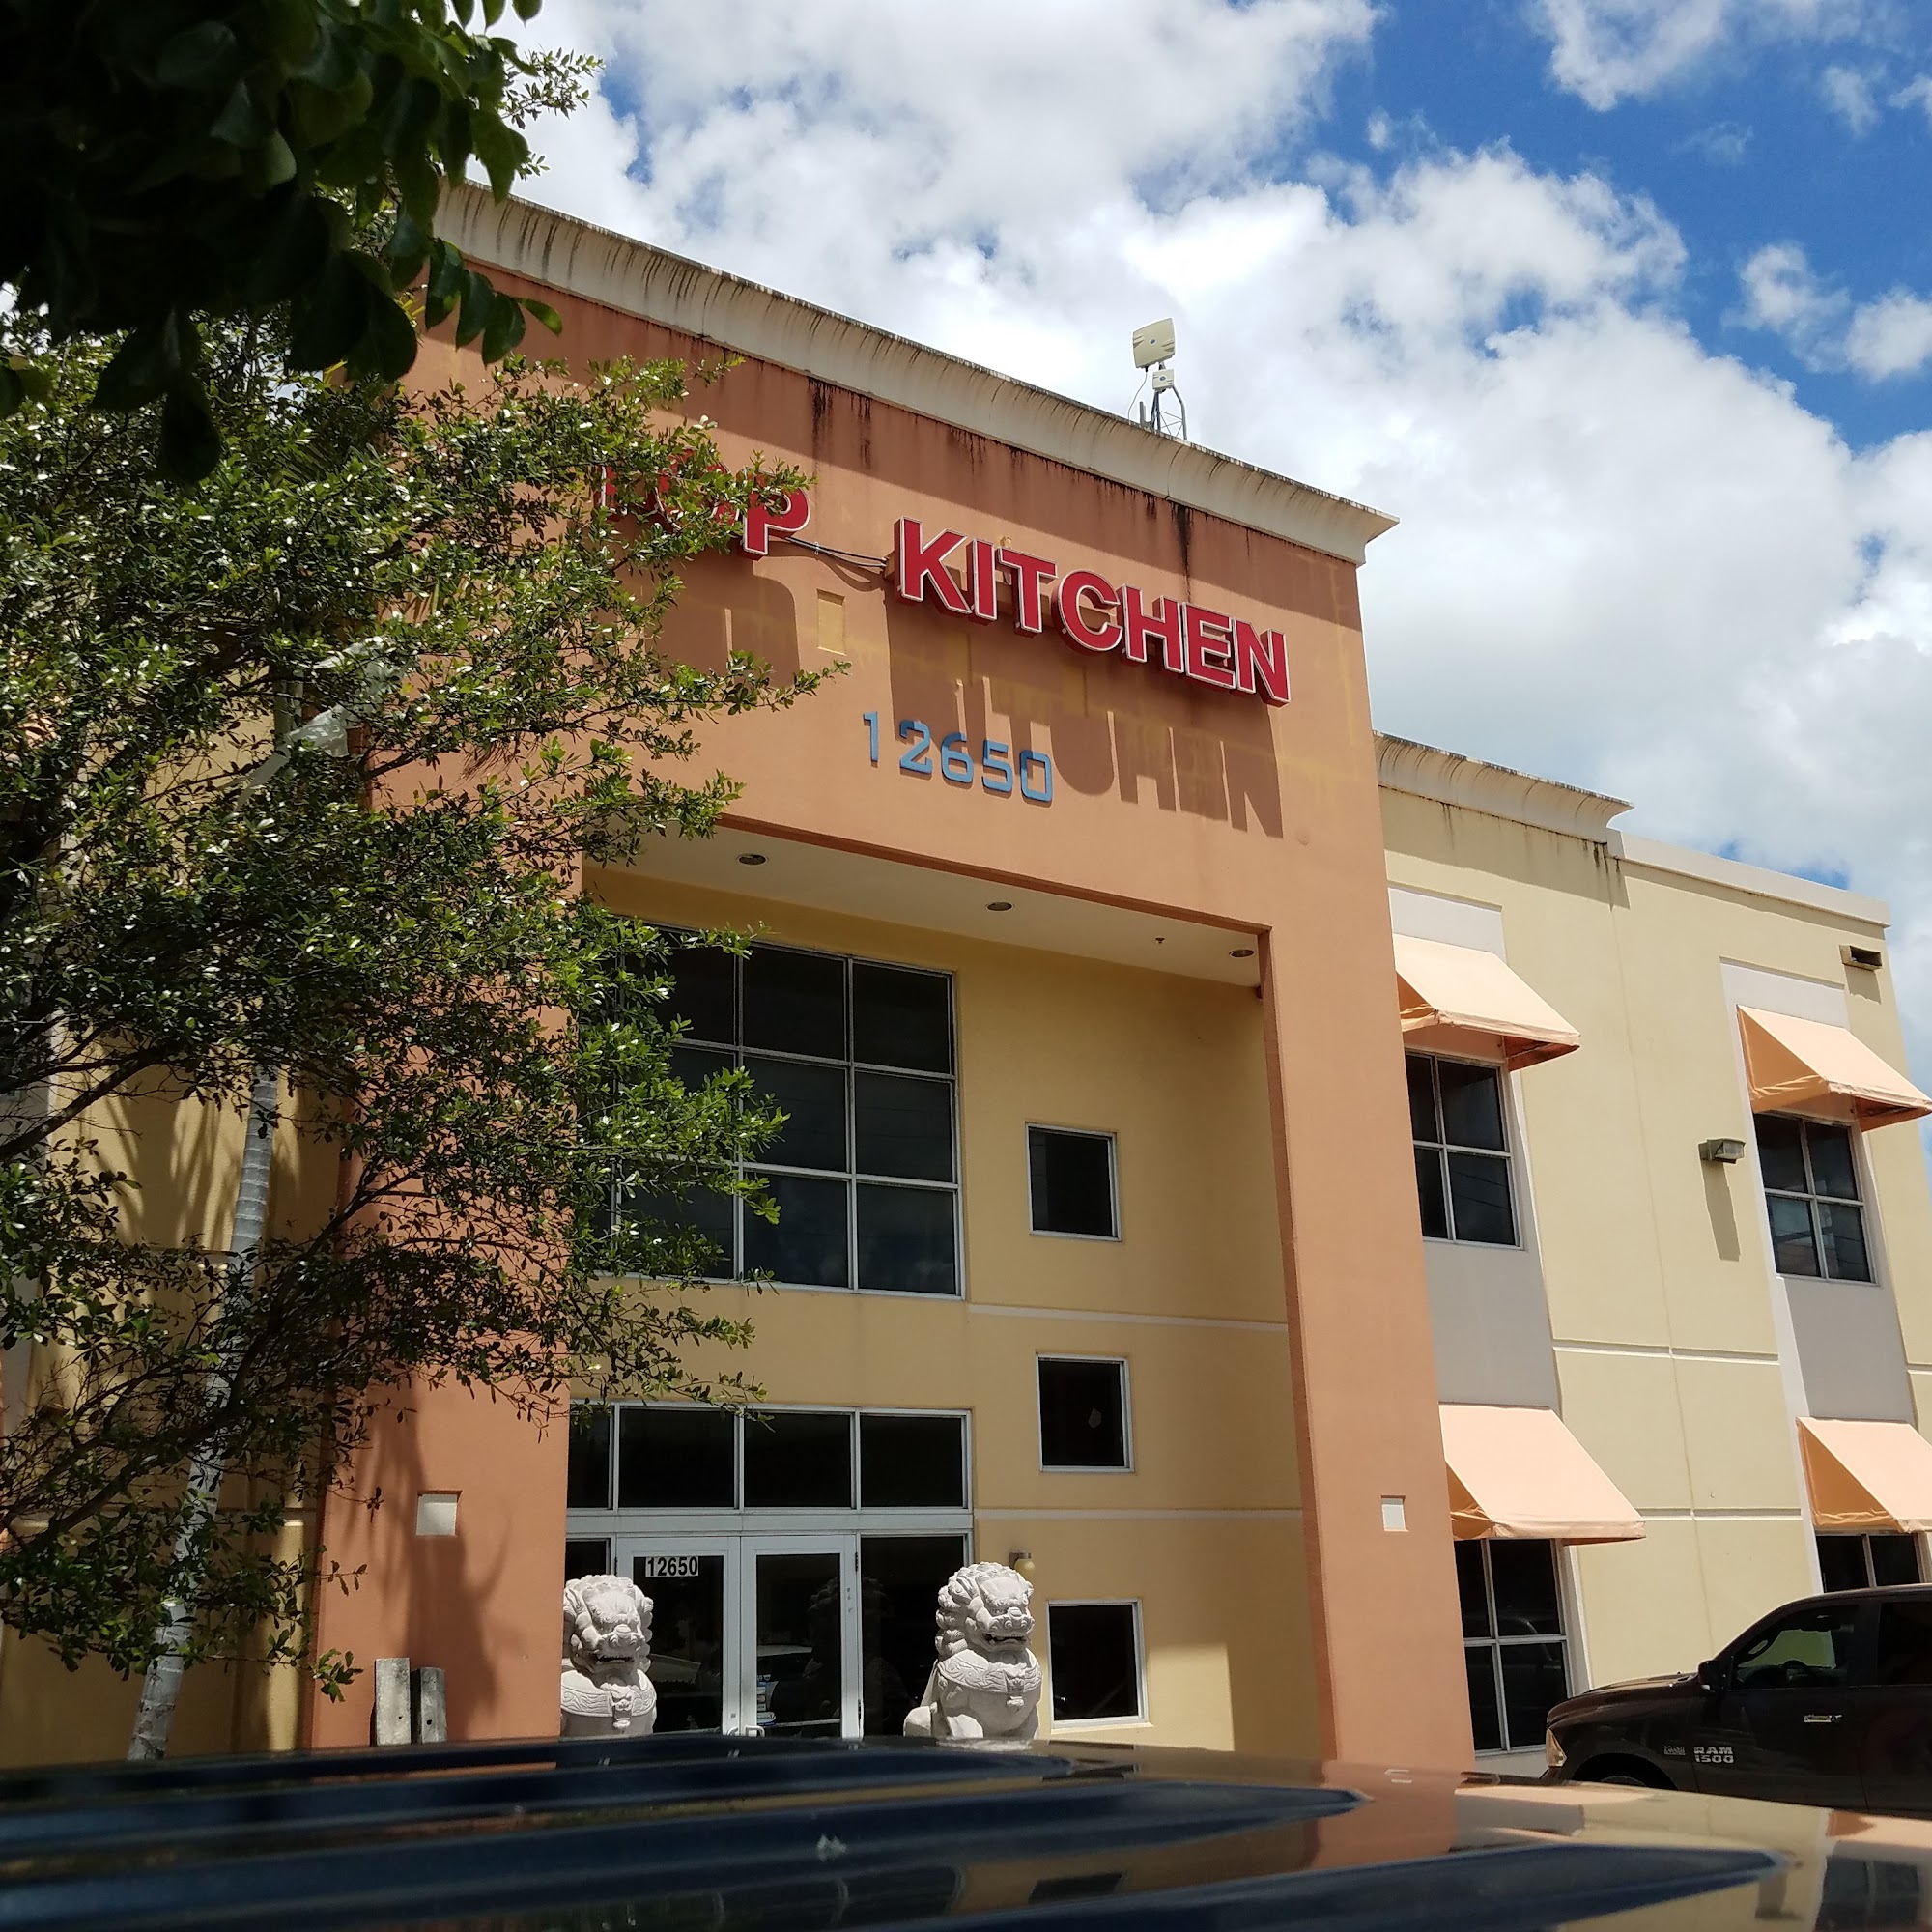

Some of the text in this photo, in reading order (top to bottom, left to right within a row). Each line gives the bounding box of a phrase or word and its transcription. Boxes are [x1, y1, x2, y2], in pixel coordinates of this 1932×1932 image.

[896, 516, 1292, 706] KITCHEN
[864, 710, 1052, 803] 12650
[647, 1556, 698, 1577] 12650
[1693, 1746, 1733, 1755] RAM
[1694, 1754, 1734, 1764] 1500
